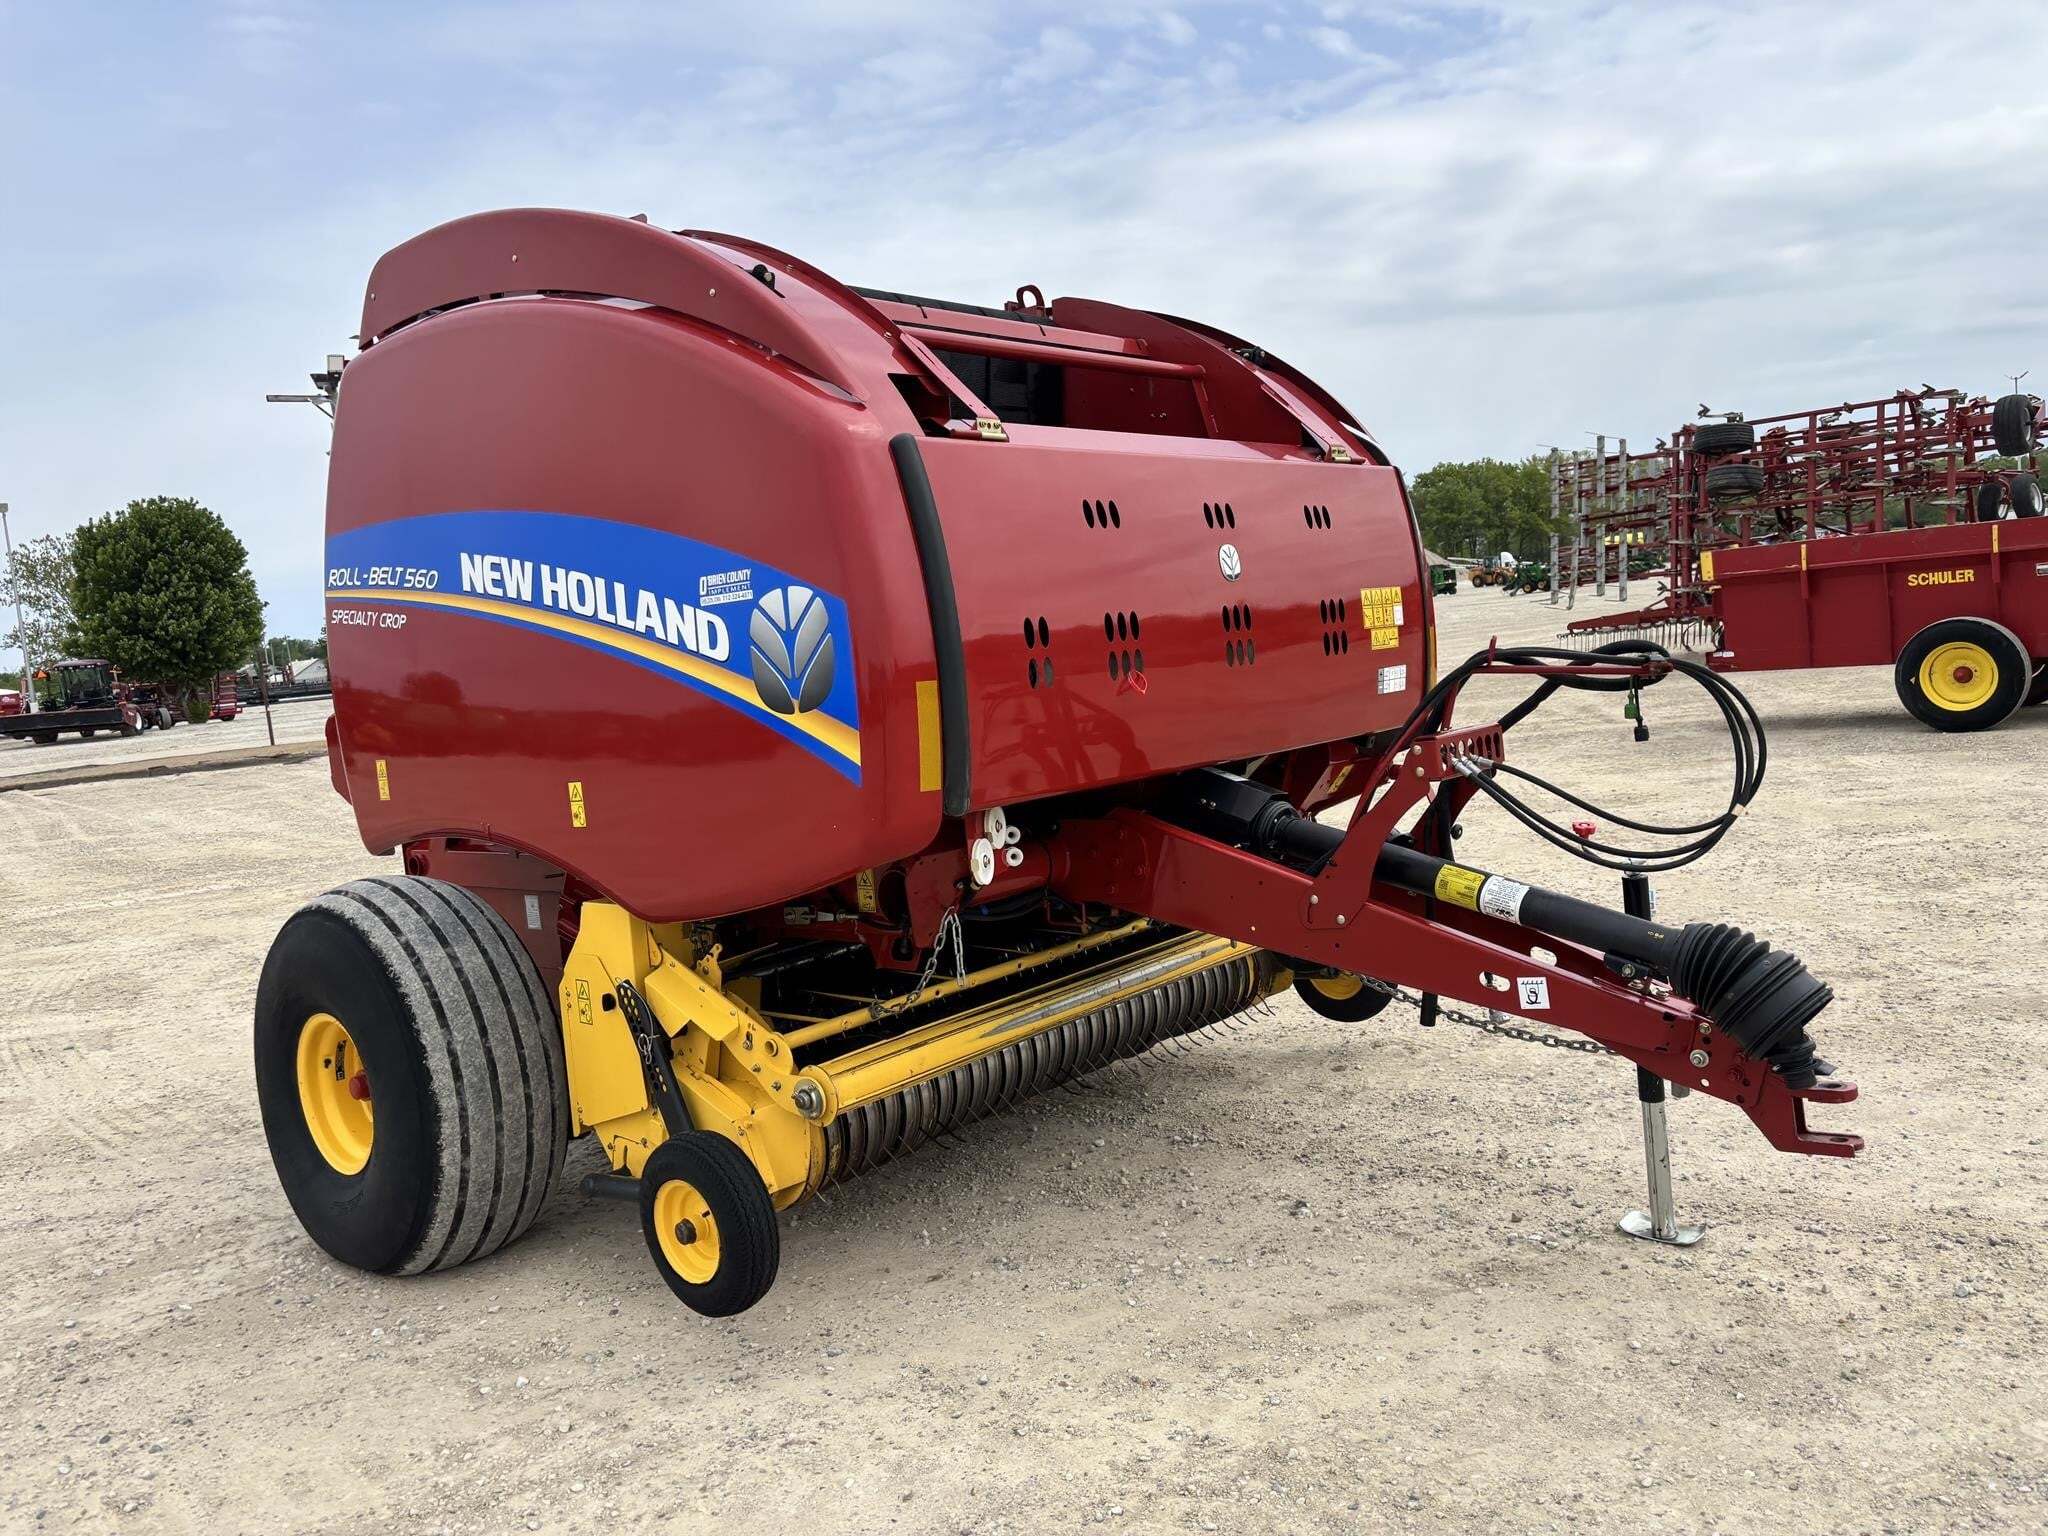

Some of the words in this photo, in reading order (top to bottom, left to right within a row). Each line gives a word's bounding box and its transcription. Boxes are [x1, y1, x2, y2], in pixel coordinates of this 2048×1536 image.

[328, 567, 403, 587] ROLL-BELT
[404, 568, 438, 589] 560
[727, 568, 752, 583] COUNTY
[1907, 569, 1975, 587] SCHULER
[708, 583, 751, 595] IMPLEMENT
[460, 552, 533, 602] NEW
[540, 563, 730, 662] HOLLAND
[331, 609, 379, 627] SPECIALTY
[379, 613, 408, 630] CROP
